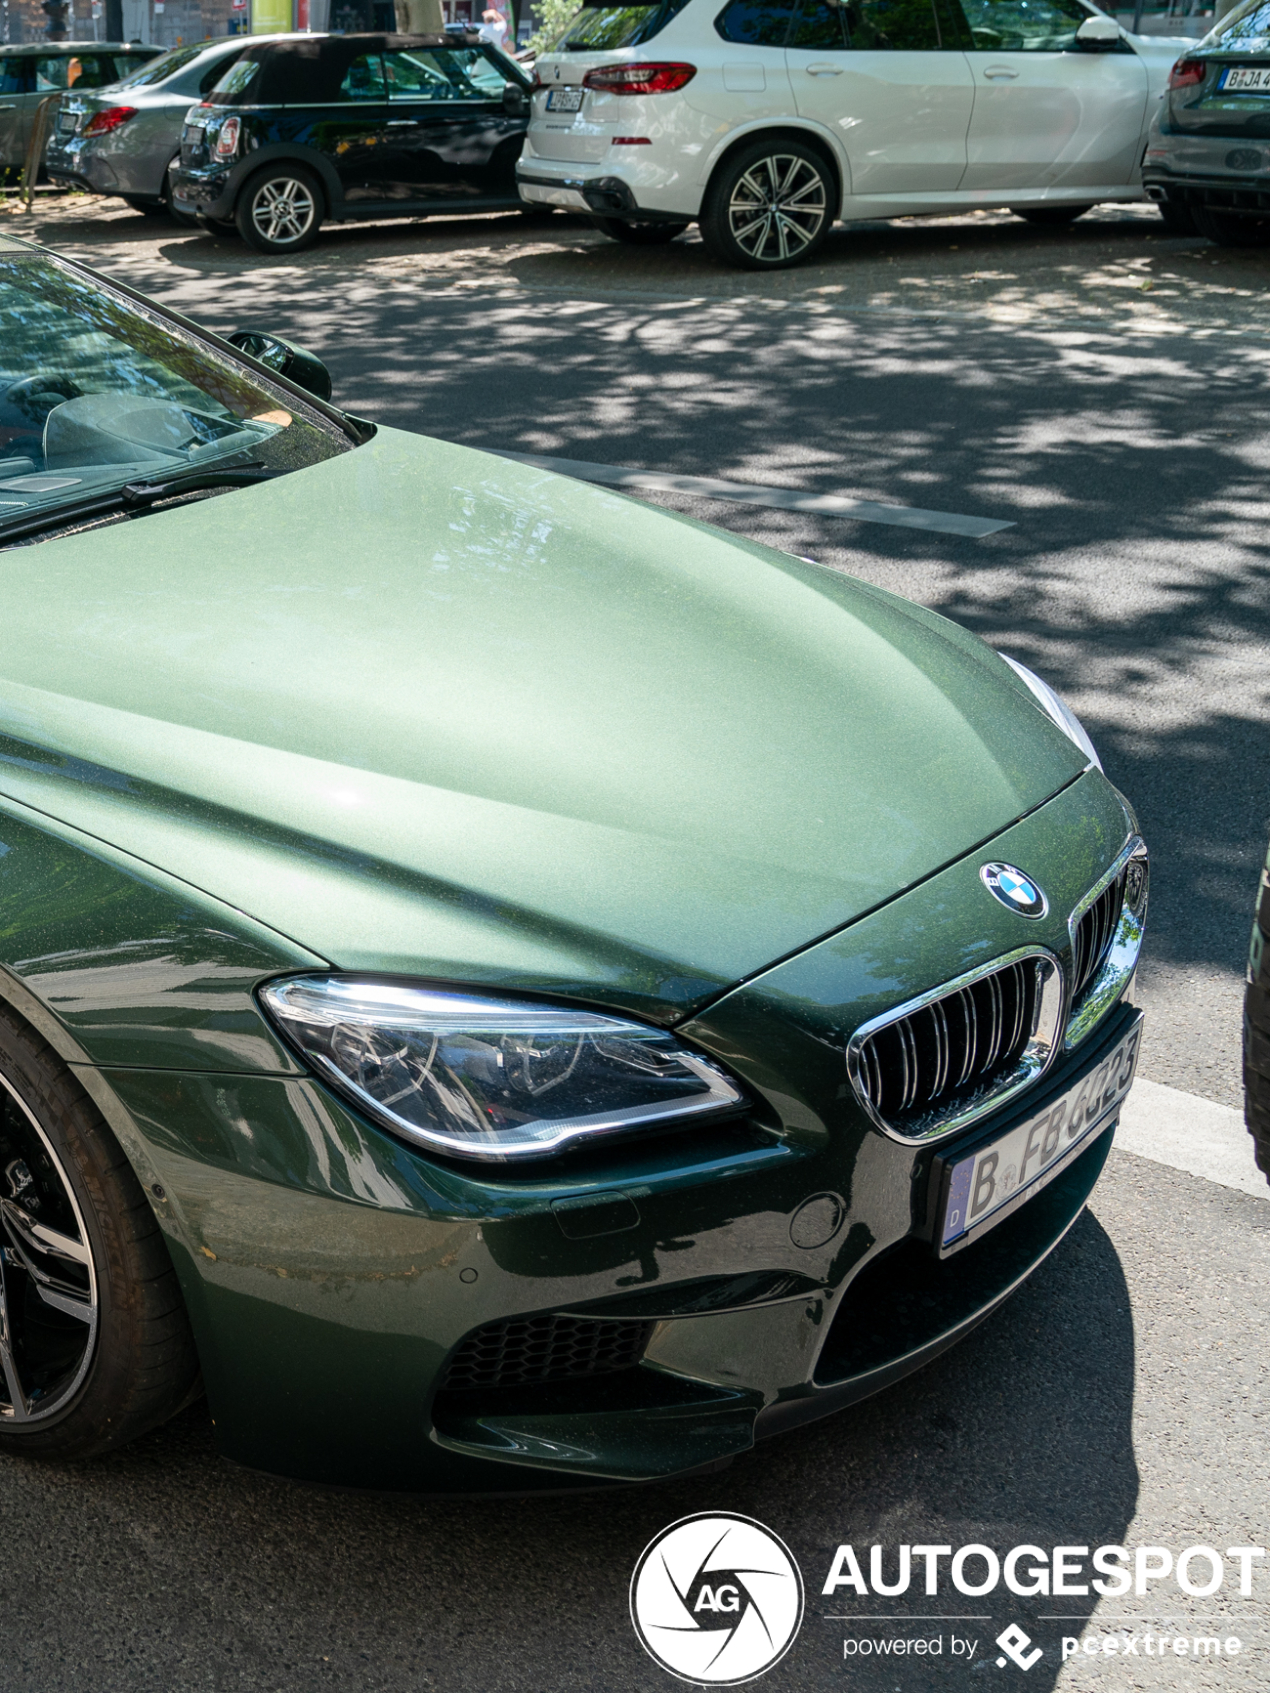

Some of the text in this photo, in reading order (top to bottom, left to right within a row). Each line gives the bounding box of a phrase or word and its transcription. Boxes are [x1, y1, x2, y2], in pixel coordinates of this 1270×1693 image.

[1229, 72, 1239, 87] B
[1244, 71, 1262, 87] JA
[971, 1150, 999, 1219] B
[950, 1209, 960, 1228] D
